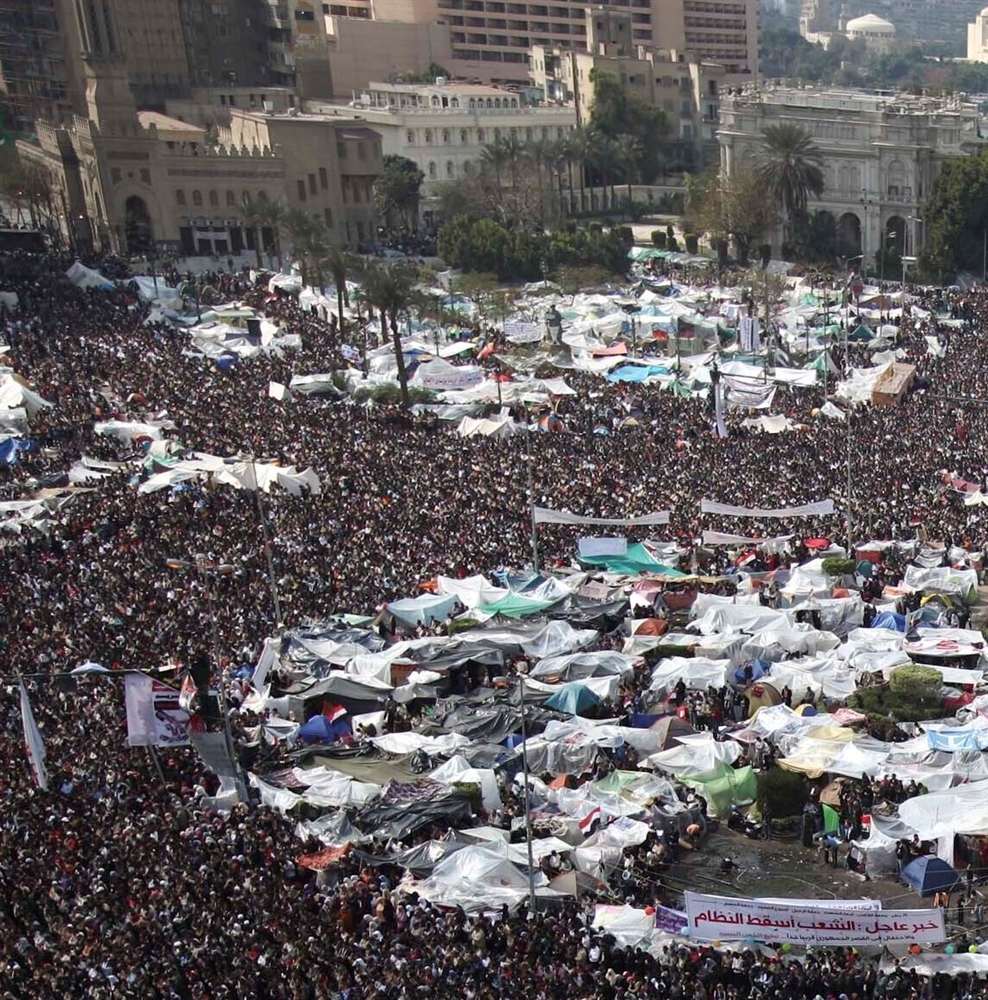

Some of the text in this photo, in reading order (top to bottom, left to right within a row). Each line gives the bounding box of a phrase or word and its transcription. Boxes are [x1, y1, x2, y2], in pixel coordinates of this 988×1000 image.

[694, 910, 744, 928] النظام
[797, 918, 856, 931] الشعب
[865, 921, 909, 934] عاجل
[912, 920, 939, 934] خبر
